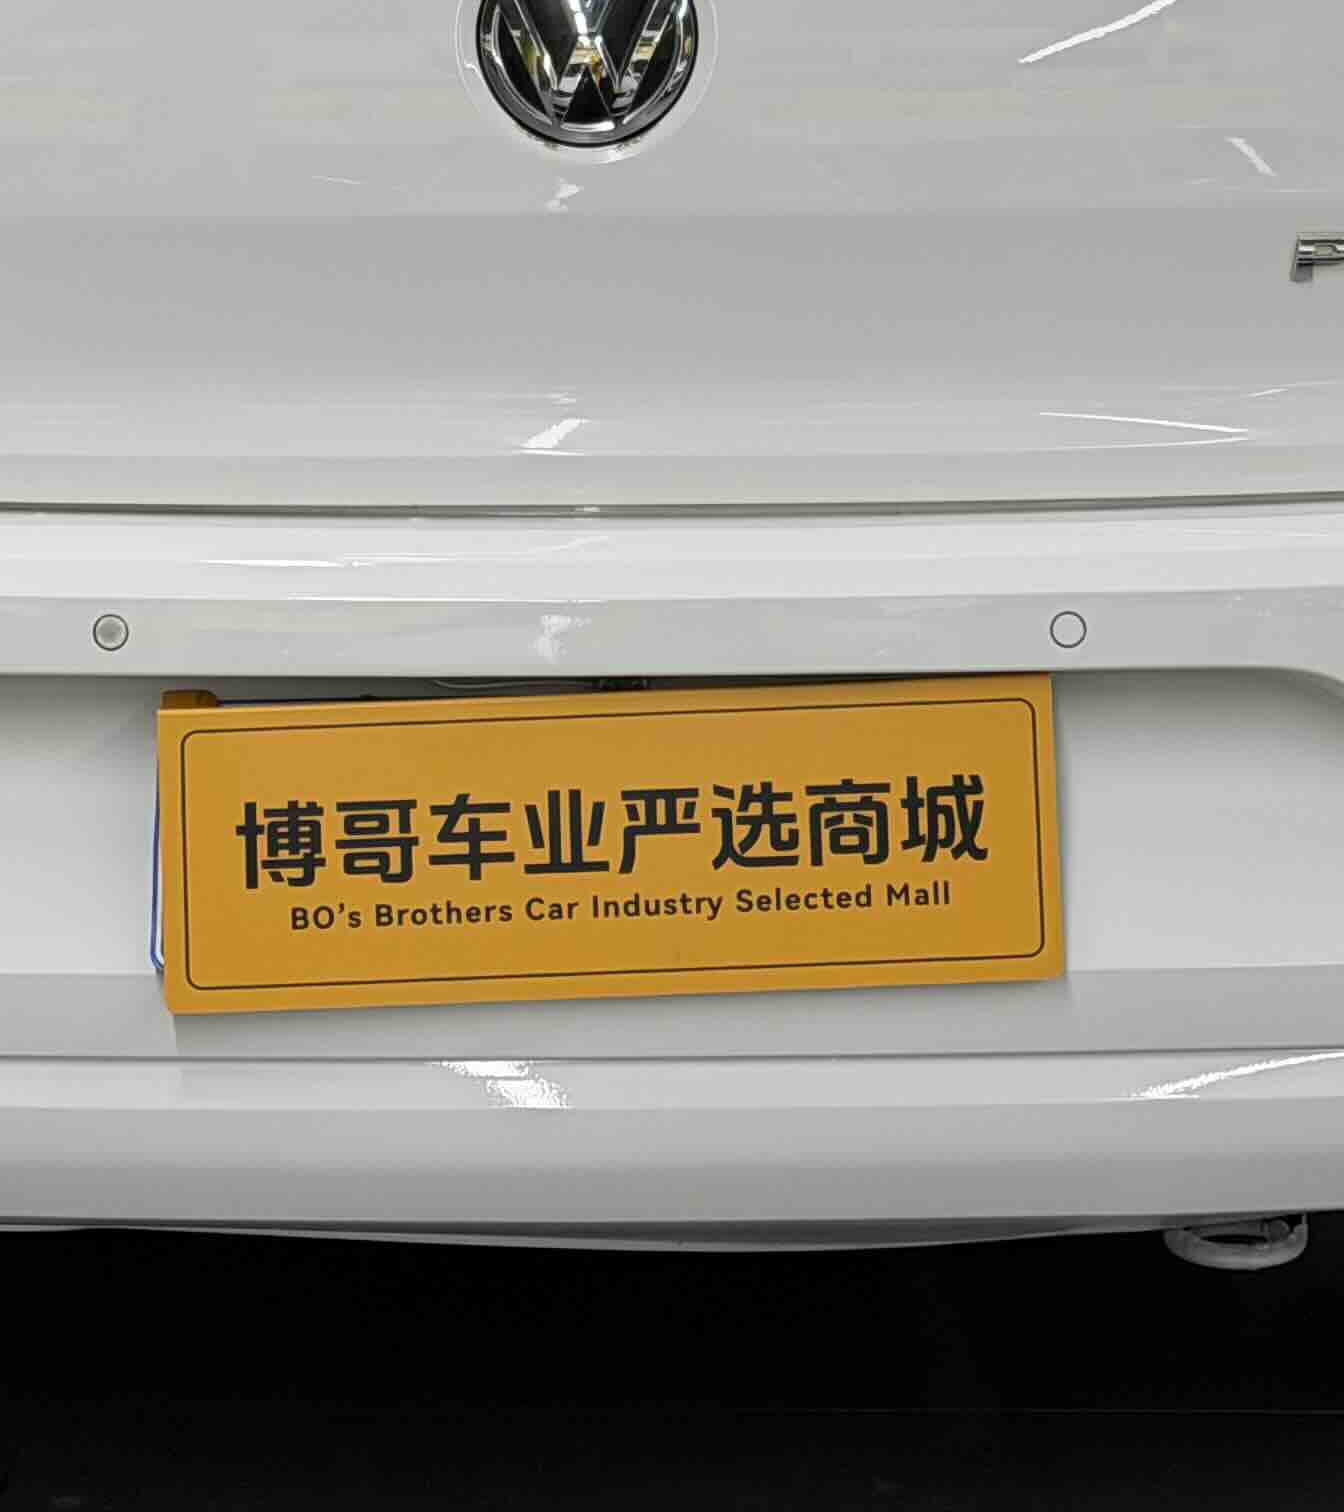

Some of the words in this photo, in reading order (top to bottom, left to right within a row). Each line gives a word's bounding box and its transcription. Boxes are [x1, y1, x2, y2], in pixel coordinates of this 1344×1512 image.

[235, 773, 990, 890] 博哥车业严选商城
[291, 904, 363, 932] BO's
[374, 899, 513, 928] Brothers
[525, 896, 578, 923] Car
[592, 892, 723, 921] Industry
[736, 883, 873, 915] Selected
[886, 881, 951, 908] Mall
